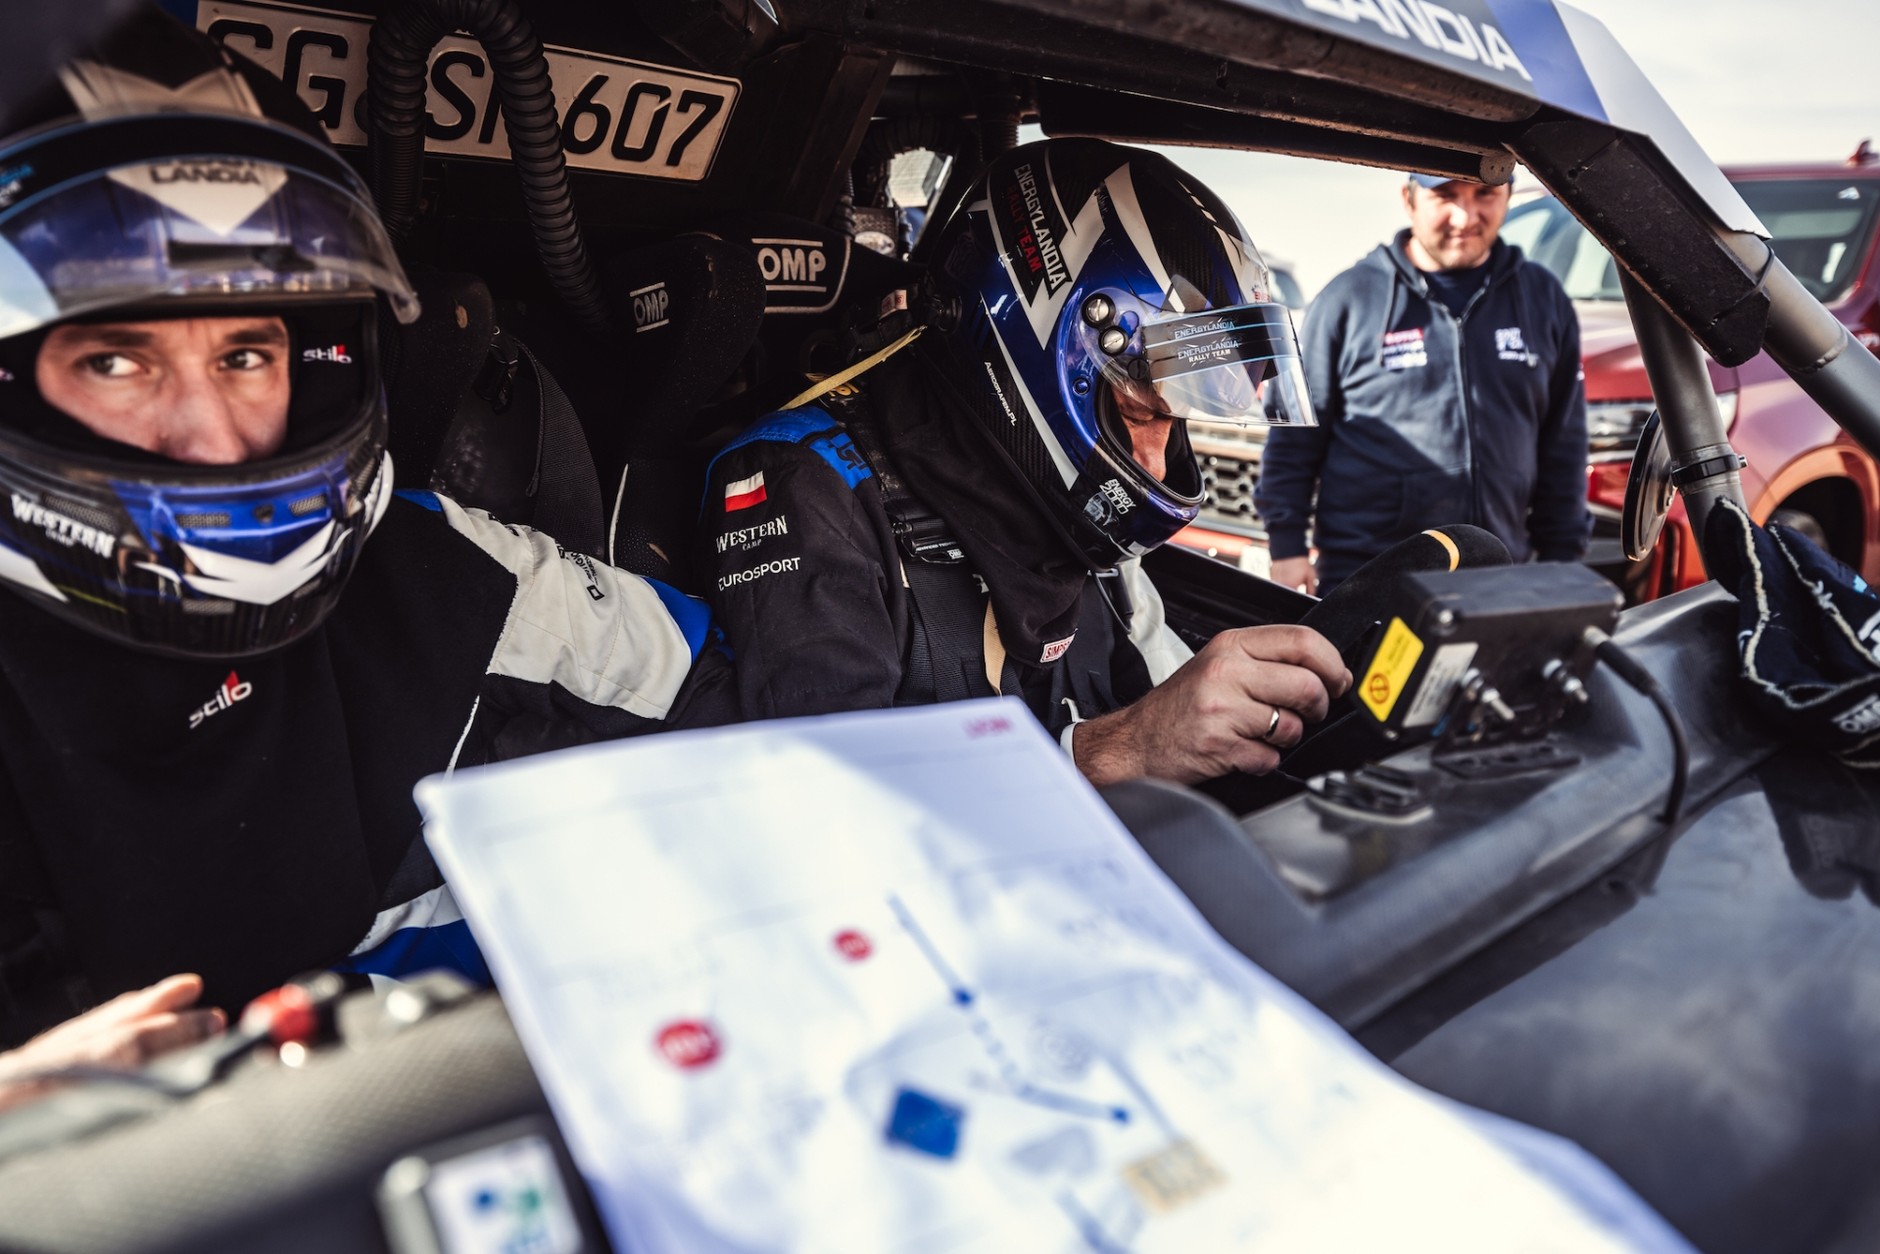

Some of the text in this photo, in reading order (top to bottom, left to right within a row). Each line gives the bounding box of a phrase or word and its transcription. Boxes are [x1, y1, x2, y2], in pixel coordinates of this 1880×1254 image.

[562, 74, 726, 167] 607
[150, 166, 262, 185] LANDIA
[1014, 163, 1068, 290] ENERGYLANDIA
[757, 247, 827, 282] OMP
[1018, 225, 1042, 273] TEAM
[633, 289, 669, 325] OMP
[1174, 320, 1236, 340] ENERGYLANDIA
[1177, 339, 1240, 360] ENERGYLANDIA
[1188, 348, 1231, 363] RALLY TEAM
[1099, 482, 1130, 515] 2000
[1107, 478, 1137, 508] ENERGY
[11, 493, 116, 559] WESTERN
[715, 514, 789, 554] WESTERN
[742, 538, 762, 551] CAMP
[718, 556, 801, 592] EUROSPORT
